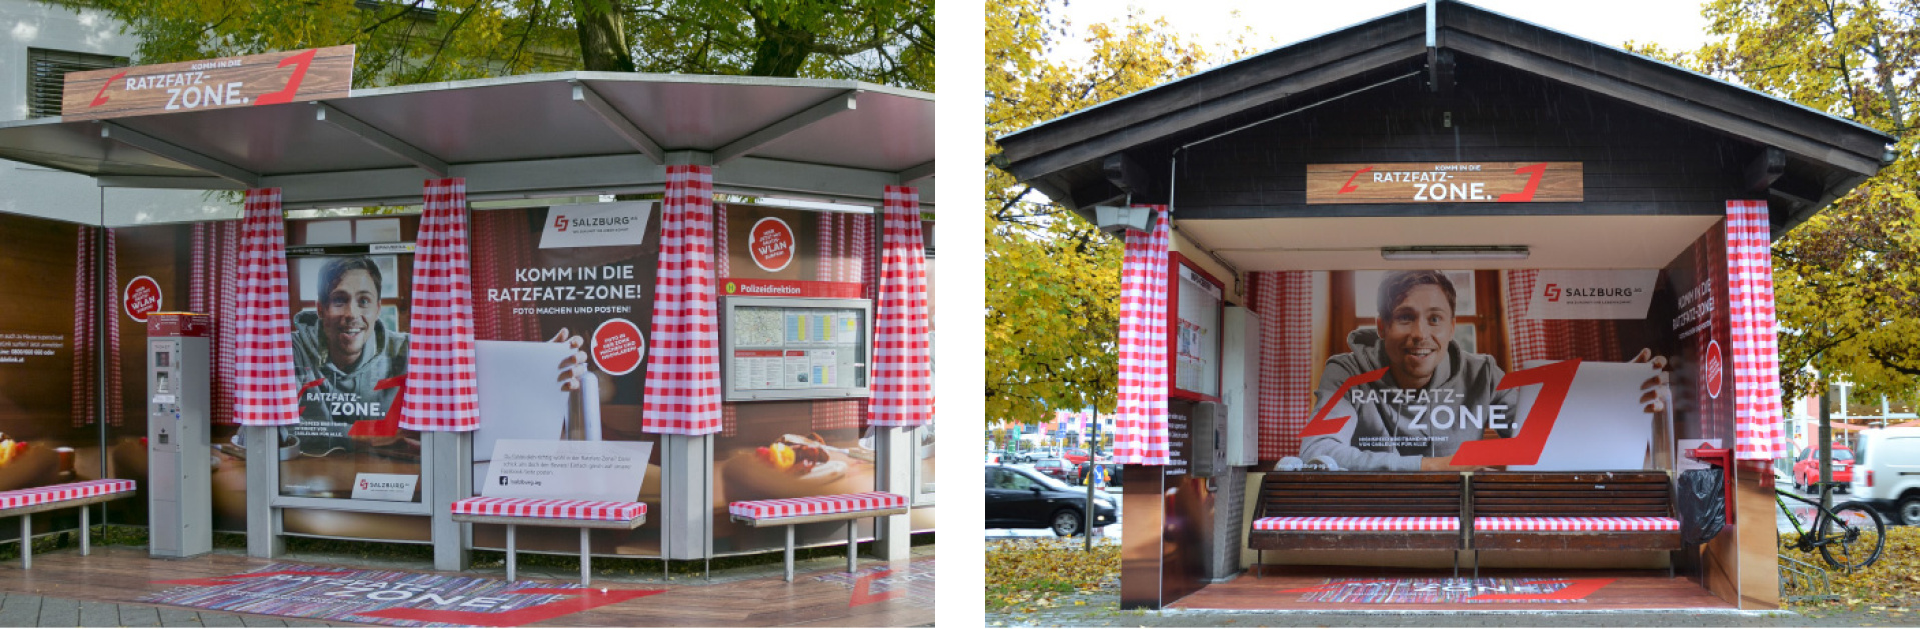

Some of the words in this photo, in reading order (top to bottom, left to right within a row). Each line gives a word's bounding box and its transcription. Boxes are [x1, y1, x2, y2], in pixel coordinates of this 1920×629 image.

[191, 62, 217, 70] KOMM
[228, 60, 242, 68] DIE
[126, 71, 211, 91] RATZFATZ-
[165, 82, 249, 110] ZONE.
[1373, 172, 1454, 182] RATZFATZ-
[1413, 183, 1492, 200] ZONE.
[572, 216, 630, 227] SALZBURG
[758, 241, 786, 256] WLAN
[515, 268, 572, 282] KOMM
[578, 266, 596, 281] IN
[602, 265, 634, 280] DIE
[488, 285, 642, 302] RATZFATZ-ZONE!
[740, 284, 800, 294] Polizeidirektion
[1566, 288, 1632, 296] SALZBURG
[131, 296, 155, 310] WLAN
[512, 306, 534, 314] FOTO
[536, 306, 572, 314] MACHEN
[594, 306, 631, 314] POSTEN!
[306, 393, 362, 402] RATZFATZ-
[1351, 388, 1465, 404] RATZFATZ-
[332, 402, 386, 416] ZONE.
[1408, 405, 1518, 430] ZONE.
[324, 590, 513, 610] ZONE.
